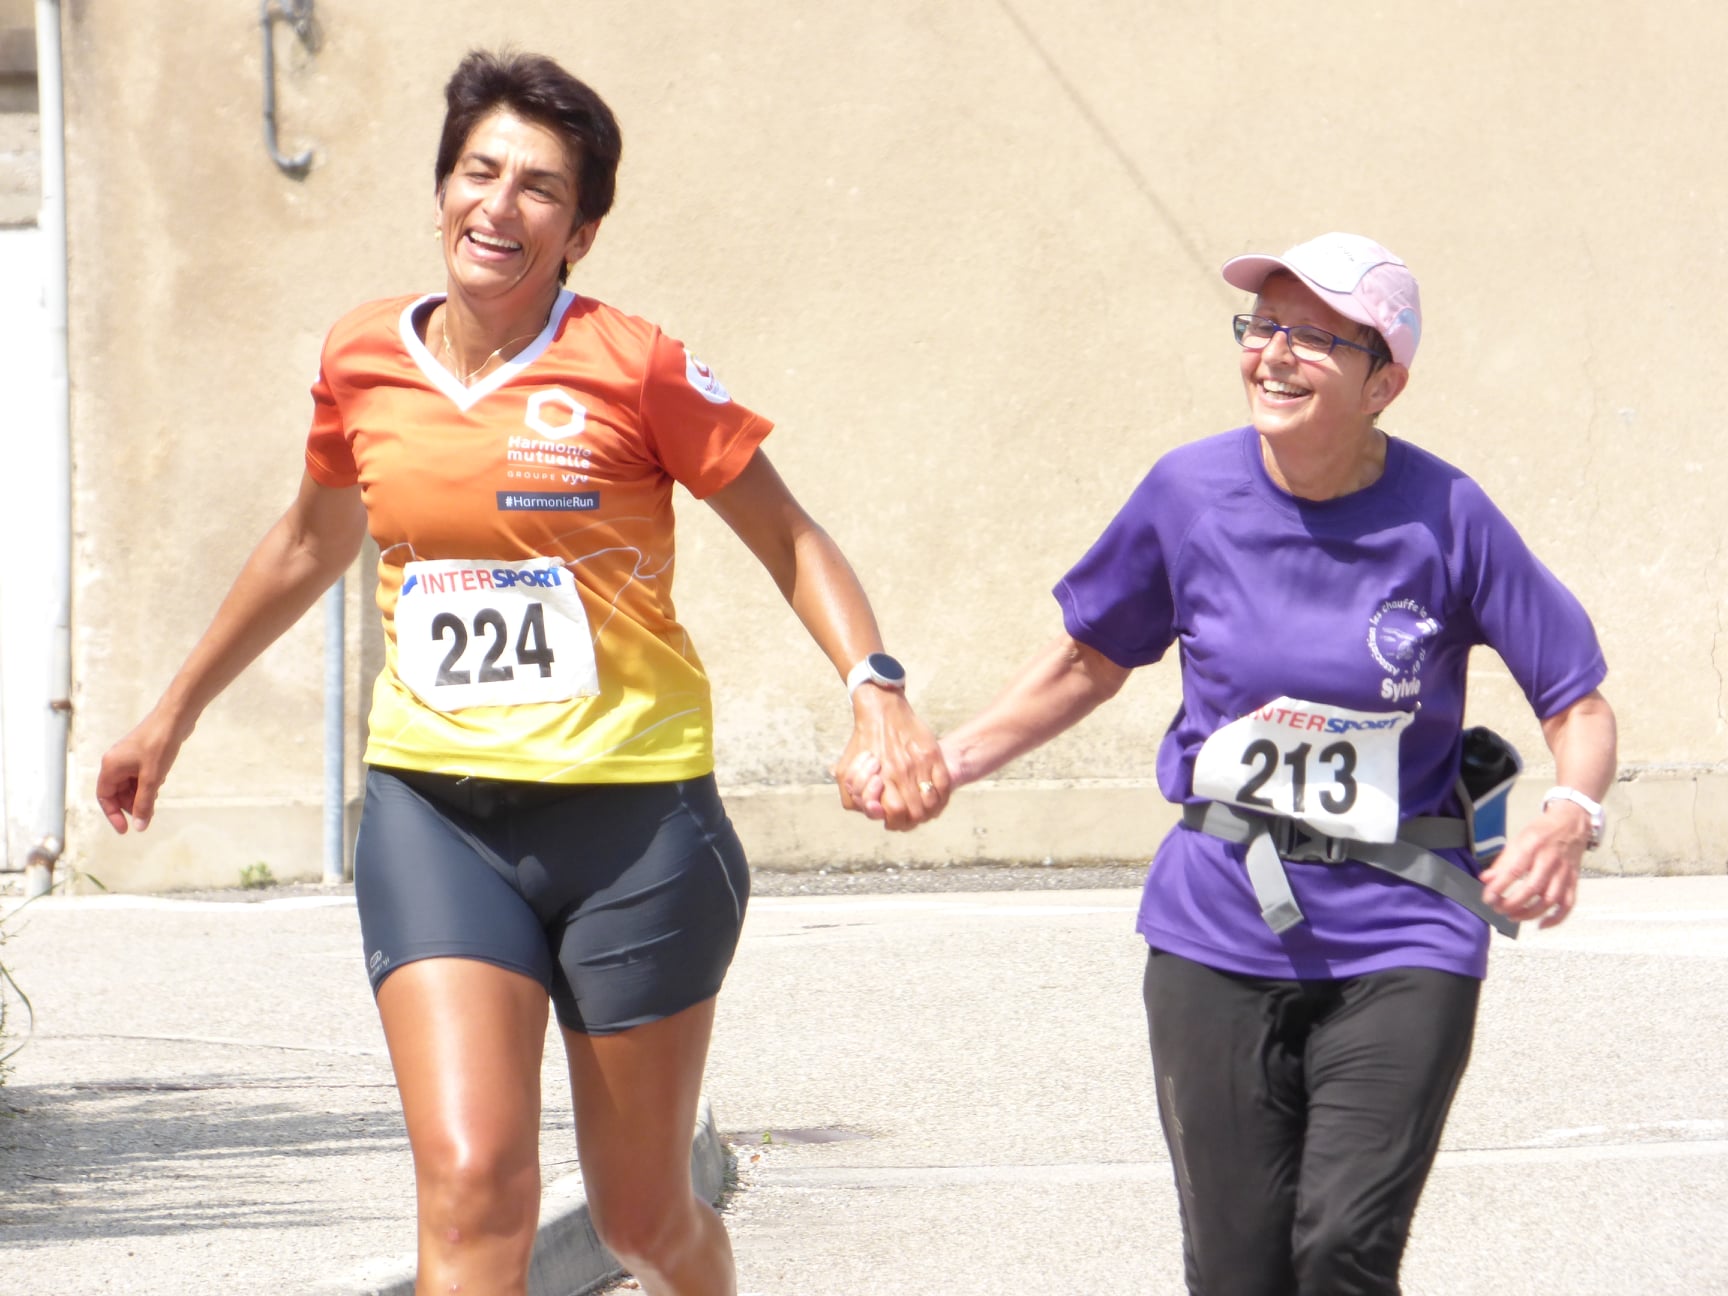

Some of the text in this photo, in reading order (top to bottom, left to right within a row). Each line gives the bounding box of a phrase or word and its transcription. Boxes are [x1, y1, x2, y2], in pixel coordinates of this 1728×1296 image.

[508, 435, 592, 457] Harmonie
[507, 449, 591, 469] mutuelle
[507, 470, 589, 486] GROUPE vyv
[505, 495, 594, 508] #HarmonieRun
[421, 567, 562, 595] INTERSPORT
[1382, 598, 1419, 613] chauffe
[431, 603, 555, 687] 224
[1381, 676, 1421, 702] Sylvie
[1235, 738, 1358, 815] 213
